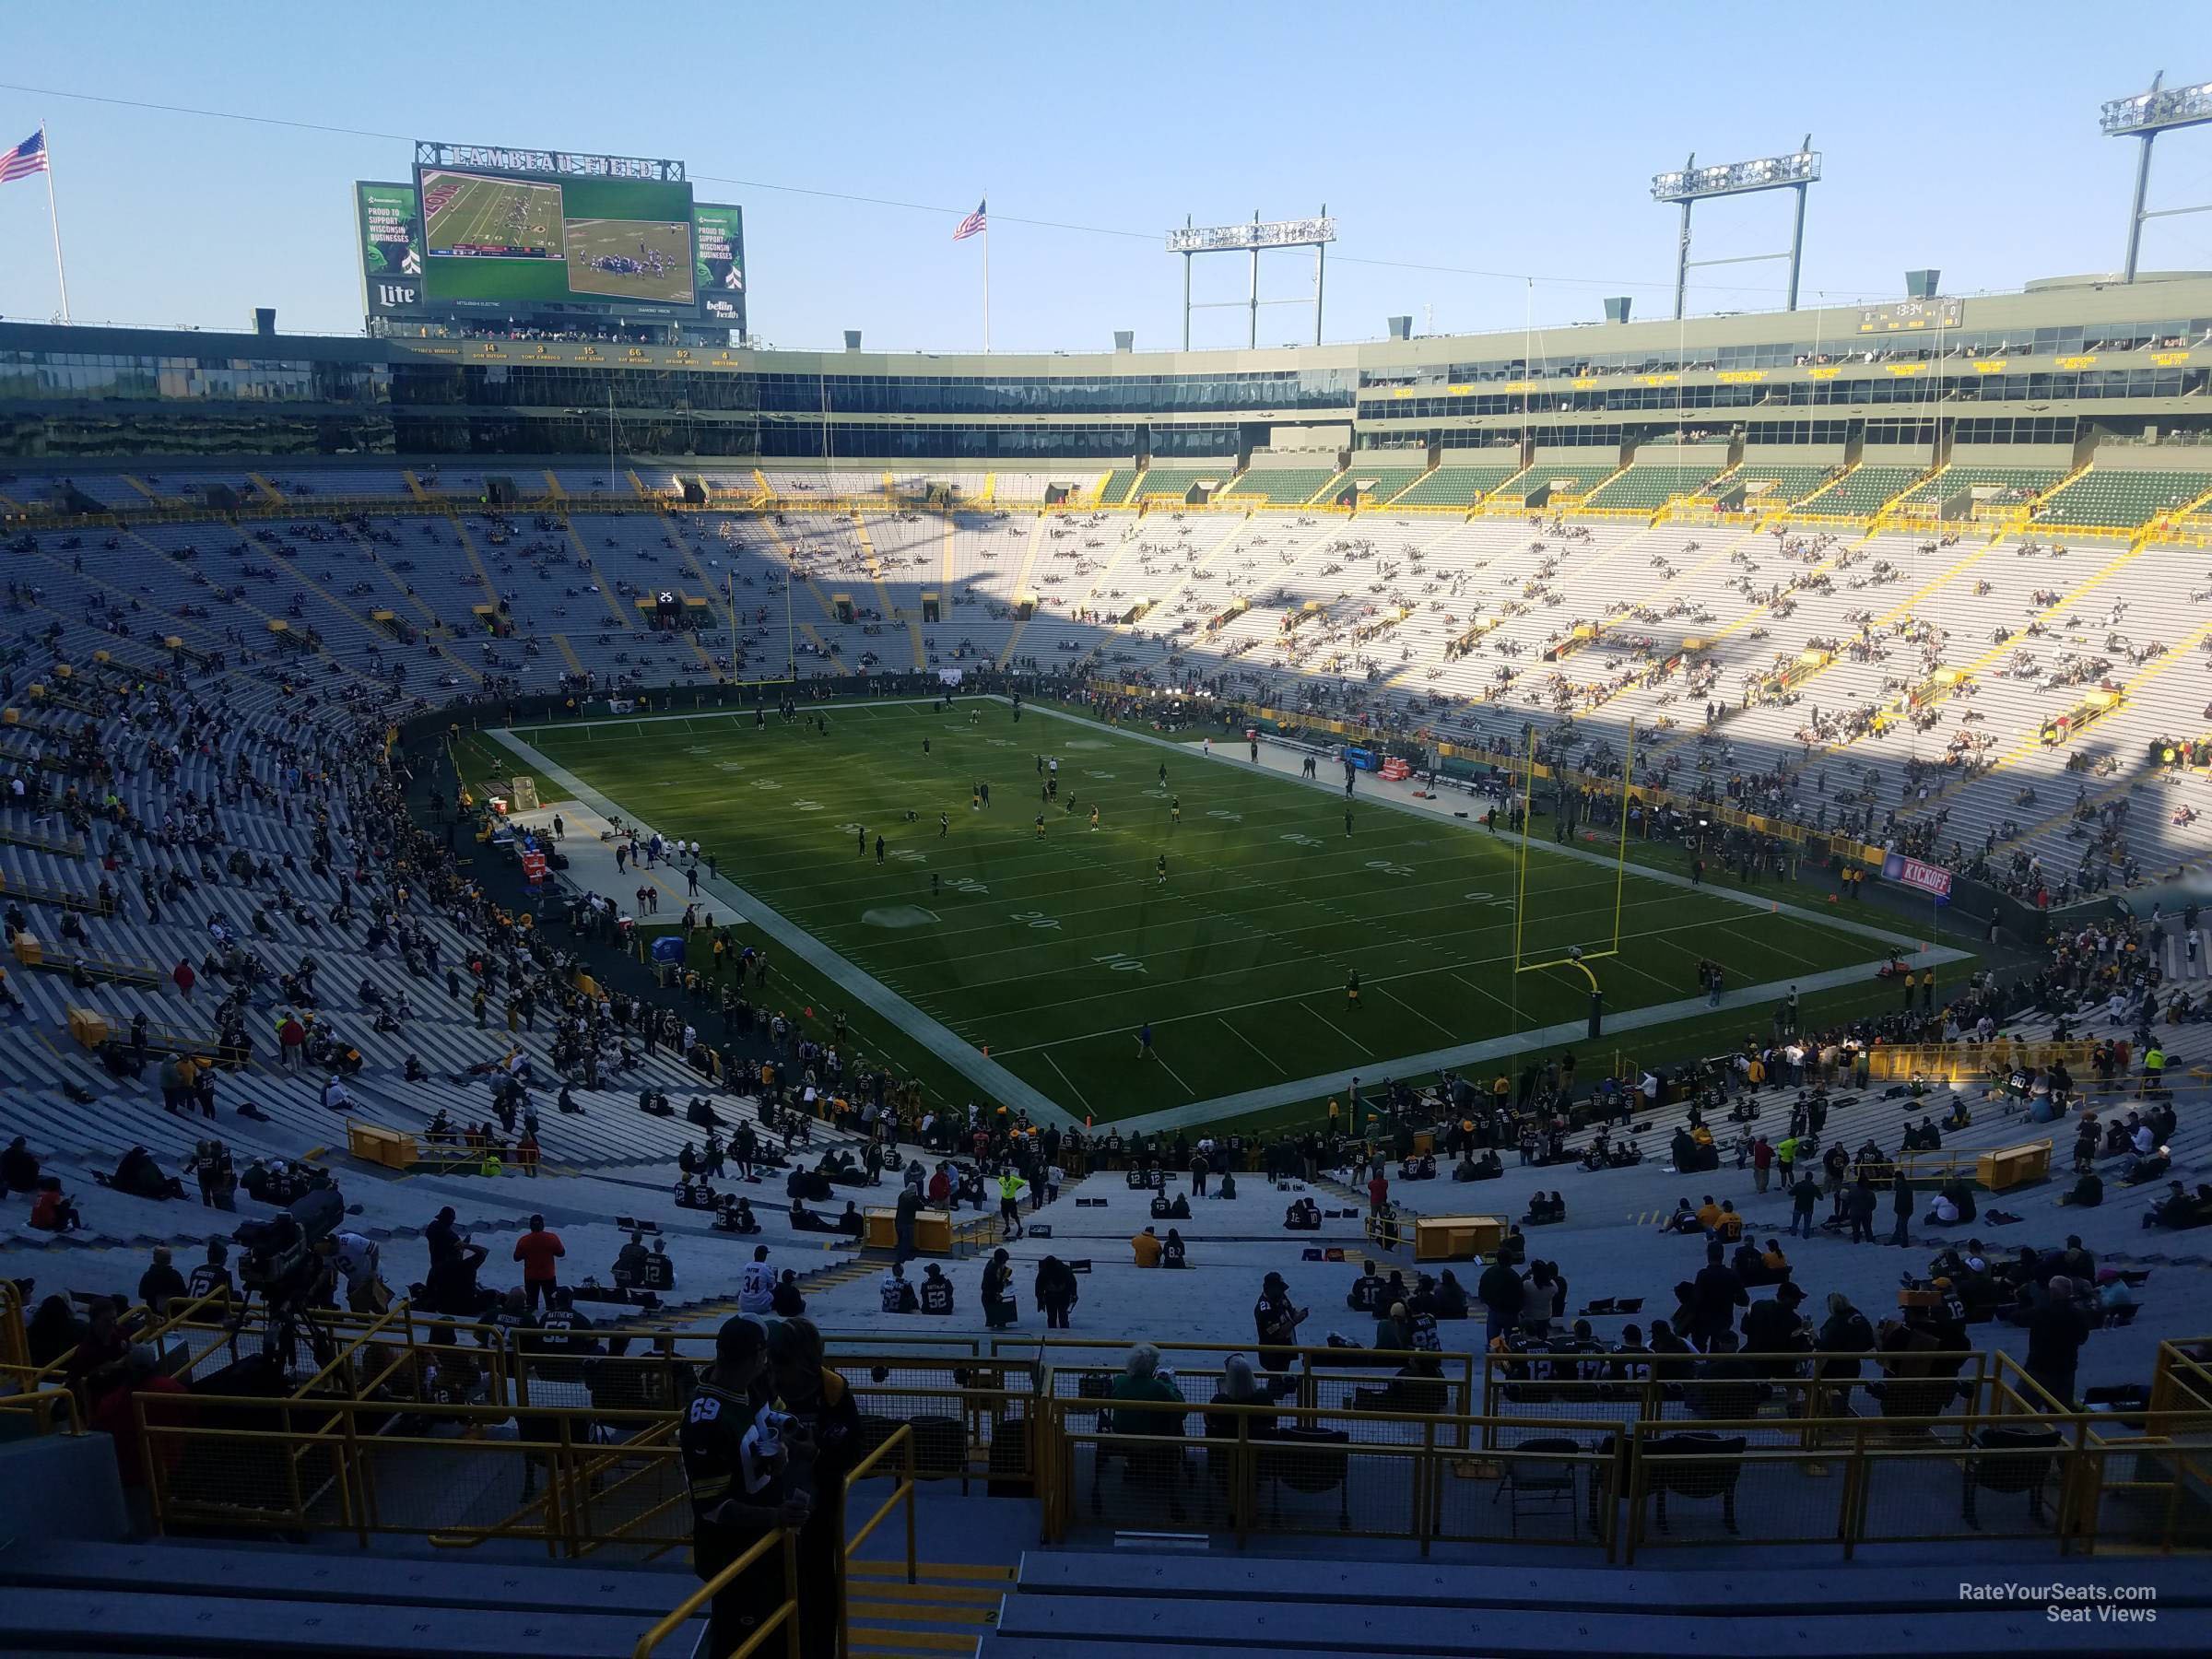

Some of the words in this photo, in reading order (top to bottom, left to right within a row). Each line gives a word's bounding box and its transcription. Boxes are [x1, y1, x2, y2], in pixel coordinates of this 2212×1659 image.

[452, 147, 575, 173] LAMBEAU
[583, 156, 654, 179] FIELD
[368, 207, 390, 216] PROUD
[392, 208, 400, 217] TO
[369, 216, 398, 225] SUPPORT
[369, 225, 406, 234] WISCONSIN
[698, 227, 717, 235] PROUD
[718, 228, 725, 236] TO
[371, 233, 409, 243] BUSINESSES
[699, 235, 724, 243] SUPPORT
[699, 242, 730, 252] WISCONSIN
[700, 251, 733, 260] BUSINESSES
[378, 284, 415, 307] Lite
[706, 300, 734, 312] bellin
[1897, 303, 1924, 317] 13:34
[716, 310, 739, 320] health
[484, 344, 495, 352] 14
[537, 345, 544, 353] 3
[583, 347, 594, 355] 15
[629, 348, 641, 357] 66
[677, 350, 689, 359] 92
[660, 592, 673, 602] 25
[1904, 864, 1948, 890] KICKOFF
[945, 877, 988, 894] 30
[1010, 911, 1060, 929] 20
[1091, 952, 1145, 972] 10
[203, 1079, 215, 1090] 12
[2010, 1075, 2026, 1089] 80
[198, 1158, 214, 1169] 52
[885, 1156, 895, 1166] 23
[1408, 1163, 1418, 1174] 87
[1130, 1175, 1141, 1184] 12
[1150, 1175, 1160, 1184] 12
[675, 1189, 686, 1202] 12
[695, 1191, 708, 1204] 52
[716, 1214, 727, 1226] 12
[644, 1265, 661, 1283] 12
[190, 1277, 211, 1298] 12
[743, 1276, 761, 1295] 34
[927, 1290, 947, 1310] 52
[1260, 1300, 1272, 1311] 21
[547, 1310, 575, 1320] MATTHEWS
[1947, 1301, 1965, 1320] 12
[542, 1321, 571, 1344] 52
[1526, 1359, 1551, 1381] 12
[1577, 1359, 1601, 1381] 17
[689, 1396, 722, 1424] 69
[1009, 1568, 1014, 1579] 1
[985, 1610, 998, 1623] 2
